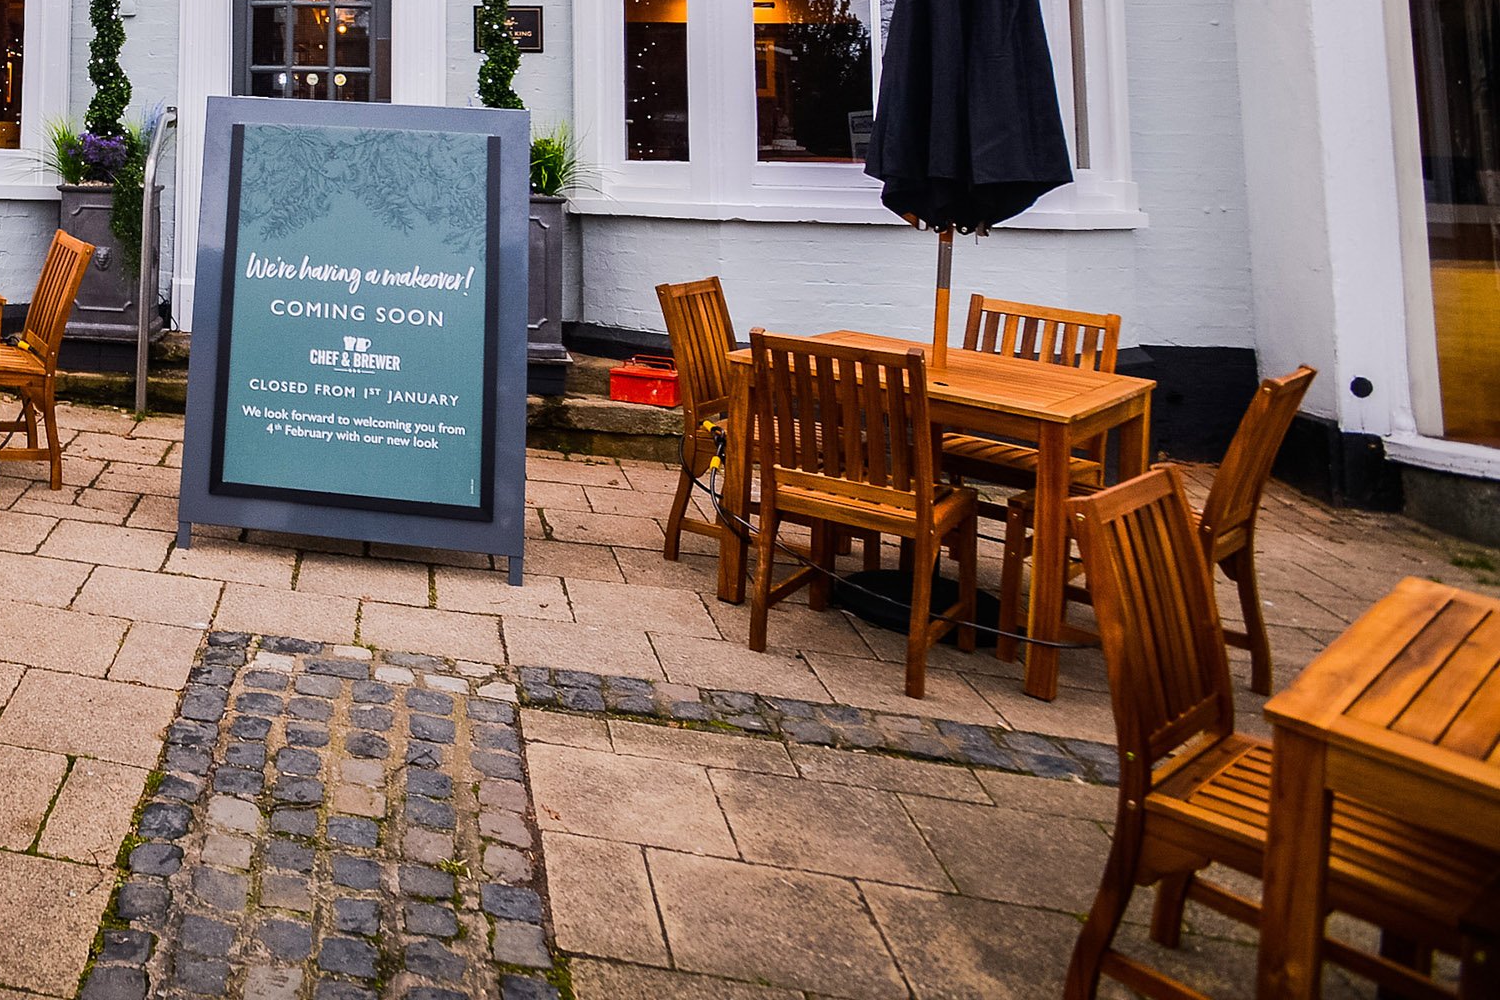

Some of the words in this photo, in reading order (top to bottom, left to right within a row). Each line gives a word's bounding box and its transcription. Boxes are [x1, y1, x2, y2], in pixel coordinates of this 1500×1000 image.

[246, 252, 297, 279] We're
[300, 255, 361, 294] having
[365, 268, 381, 284] a
[382, 266, 474, 296] makeover!
[270, 300, 365, 321] COMING
[376, 307, 444, 327] SOON
[310, 349, 340, 366] CHEF
[340, 352, 351, 367] &
[353, 352, 401, 371] BREWER
[250, 379, 308, 394] CLOSED
[314, 384, 355, 398] FROM
[387, 390, 459, 407] JANUARY
[242, 405, 261, 418] We
[264, 407, 288, 420] look
[291, 410, 334, 425] forward
[338, 414, 350, 425] to
[353, 416, 411, 433] welcoming
[414, 423, 435, 436] you
[438, 422, 465, 435] from
[266, 423, 282, 434] 4th
[285, 425, 333, 442] February
[336, 431, 360, 442] with
[364, 434, 384, 444] our
[387, 437, 410, 446] new
[413, 436, 439, 449] look
